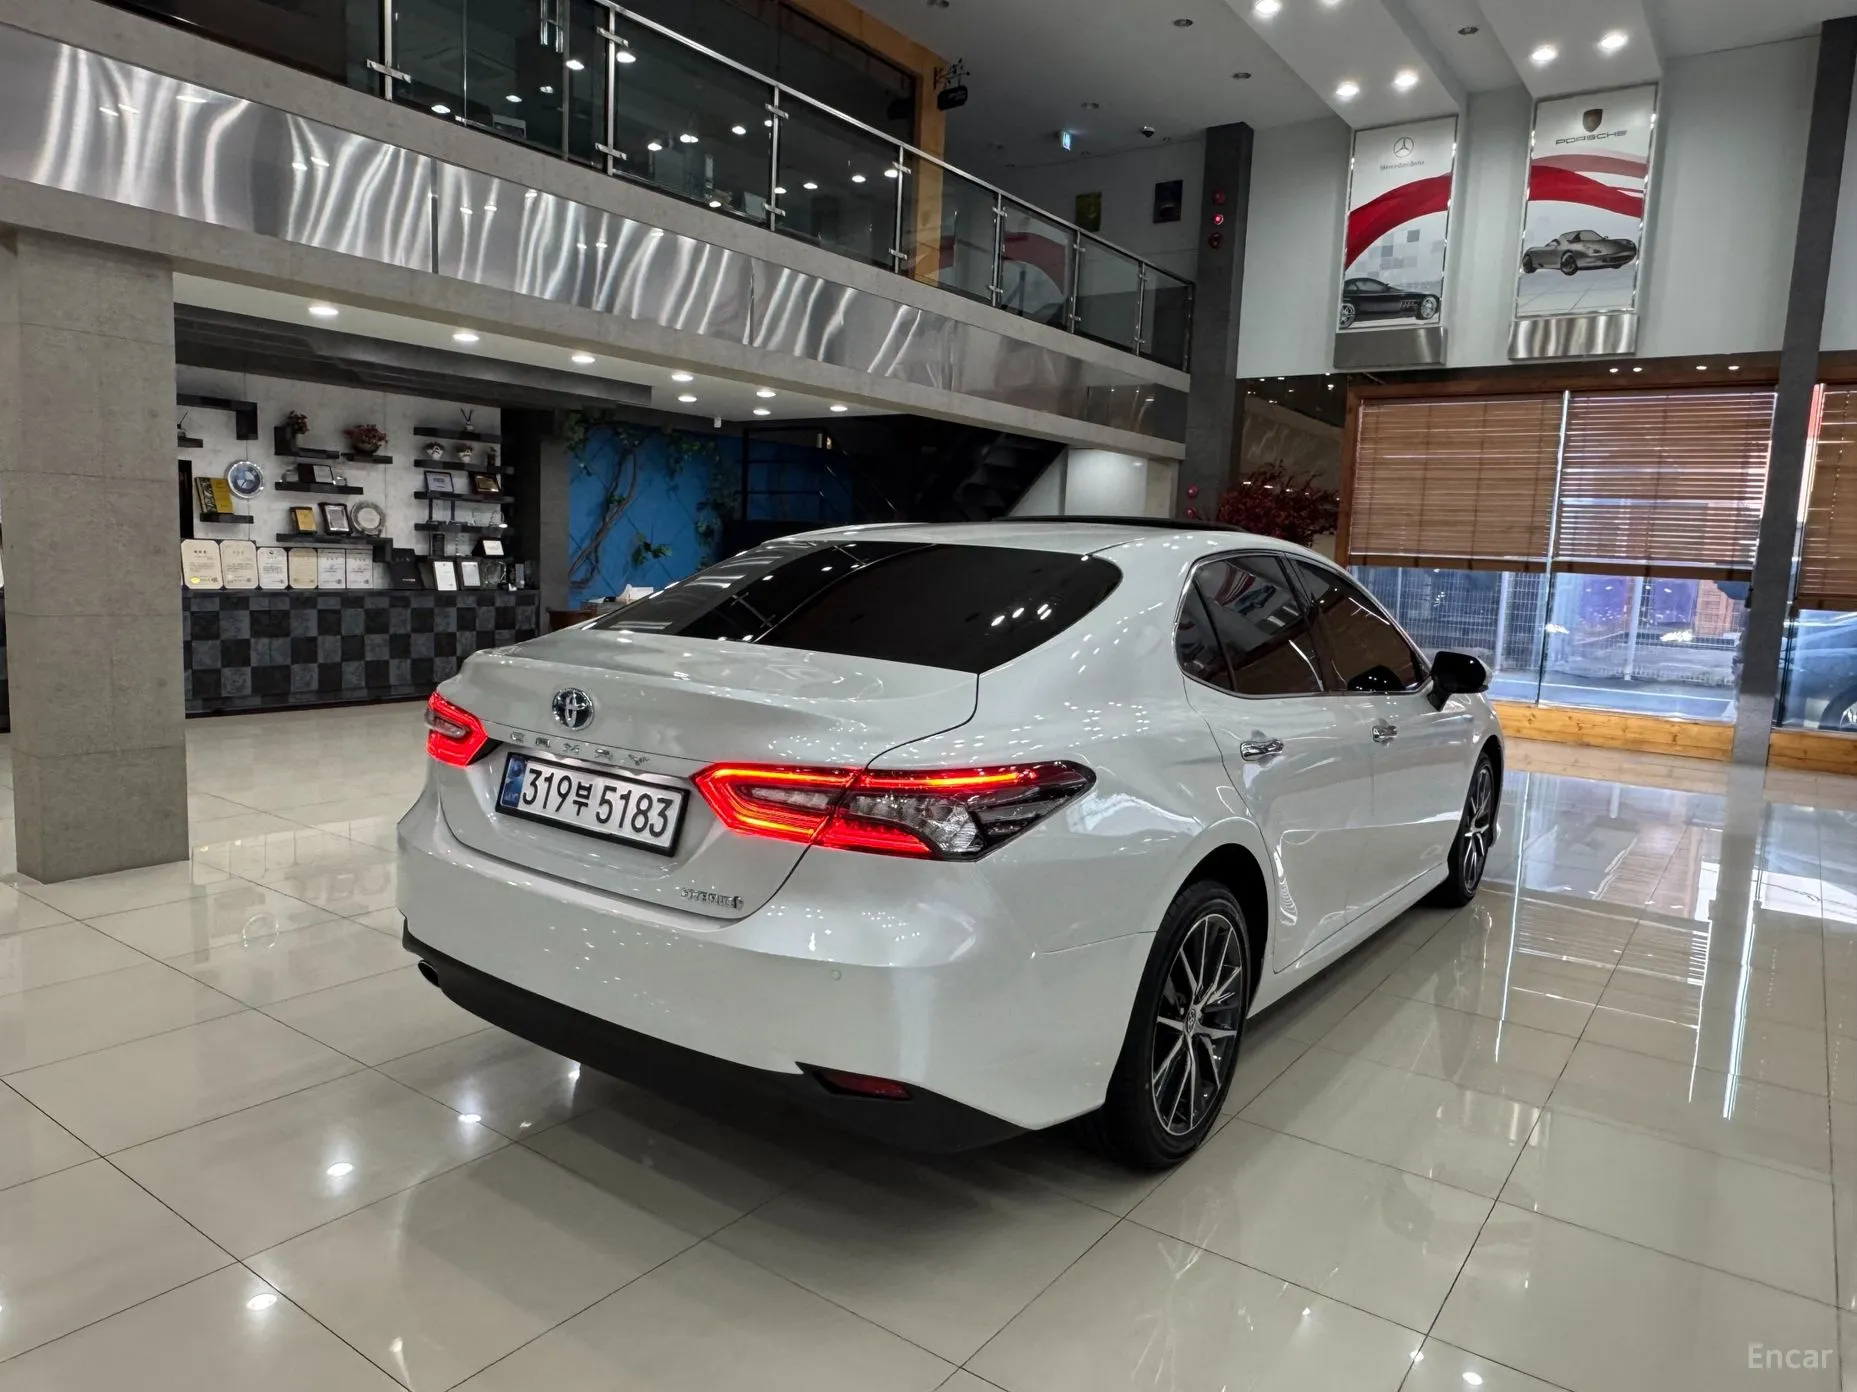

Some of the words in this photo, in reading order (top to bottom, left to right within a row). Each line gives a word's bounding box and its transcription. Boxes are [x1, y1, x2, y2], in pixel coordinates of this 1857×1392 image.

[1555, 130, 1627, 145] PORSCHE
[522, 768, 593, 817] 319부
[595, 785, 674, 838] 5183
